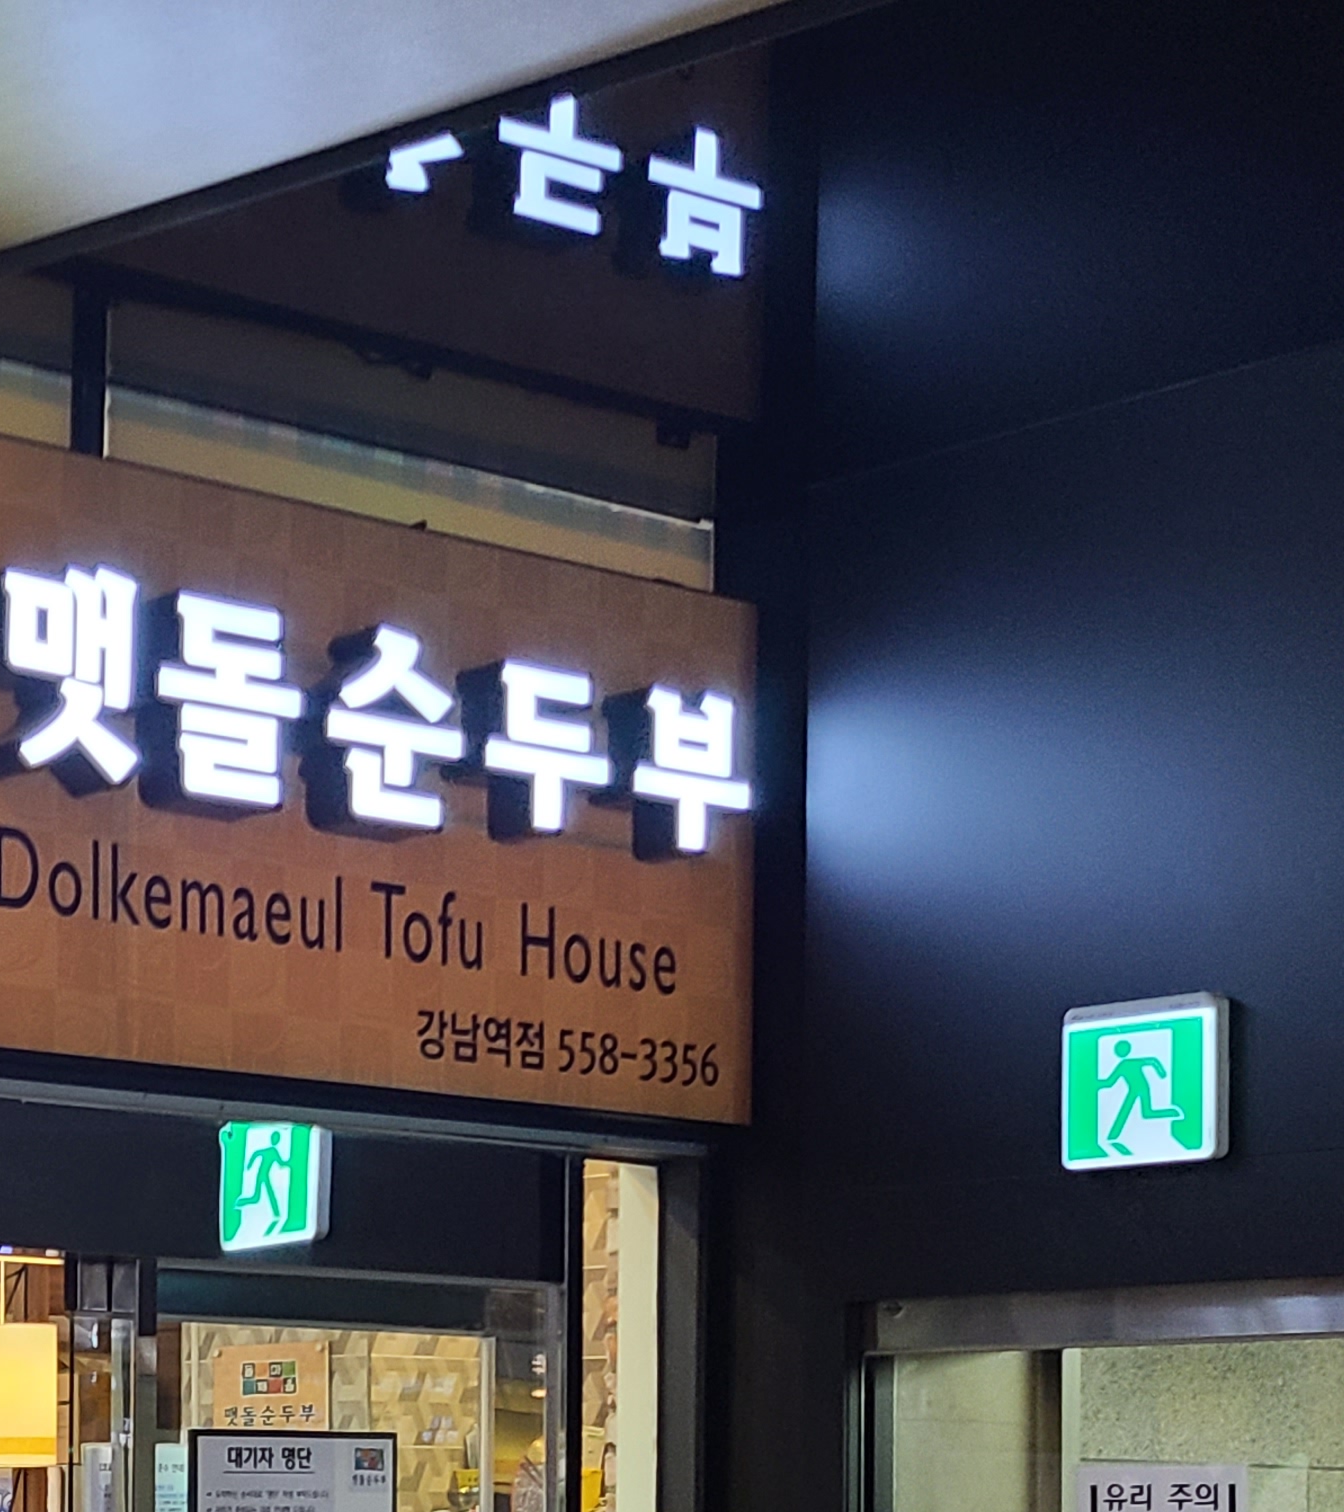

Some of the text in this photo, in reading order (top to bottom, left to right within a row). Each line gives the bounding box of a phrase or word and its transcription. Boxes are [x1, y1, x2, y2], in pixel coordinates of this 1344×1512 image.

[3, 562, 752, 854] 맷돌순두부
[370, 880, 485, 973] Tofu
[519, 905, 680, 997] House
[416, 1007, 721, 1090] 강남역점 558-3356
[223, 1403, 316, 1428] 맷돌순두부
[226, 1446, 313, 1471] 대기자 명단
[1102, 1482, 1220, 1512] 유리 주의
